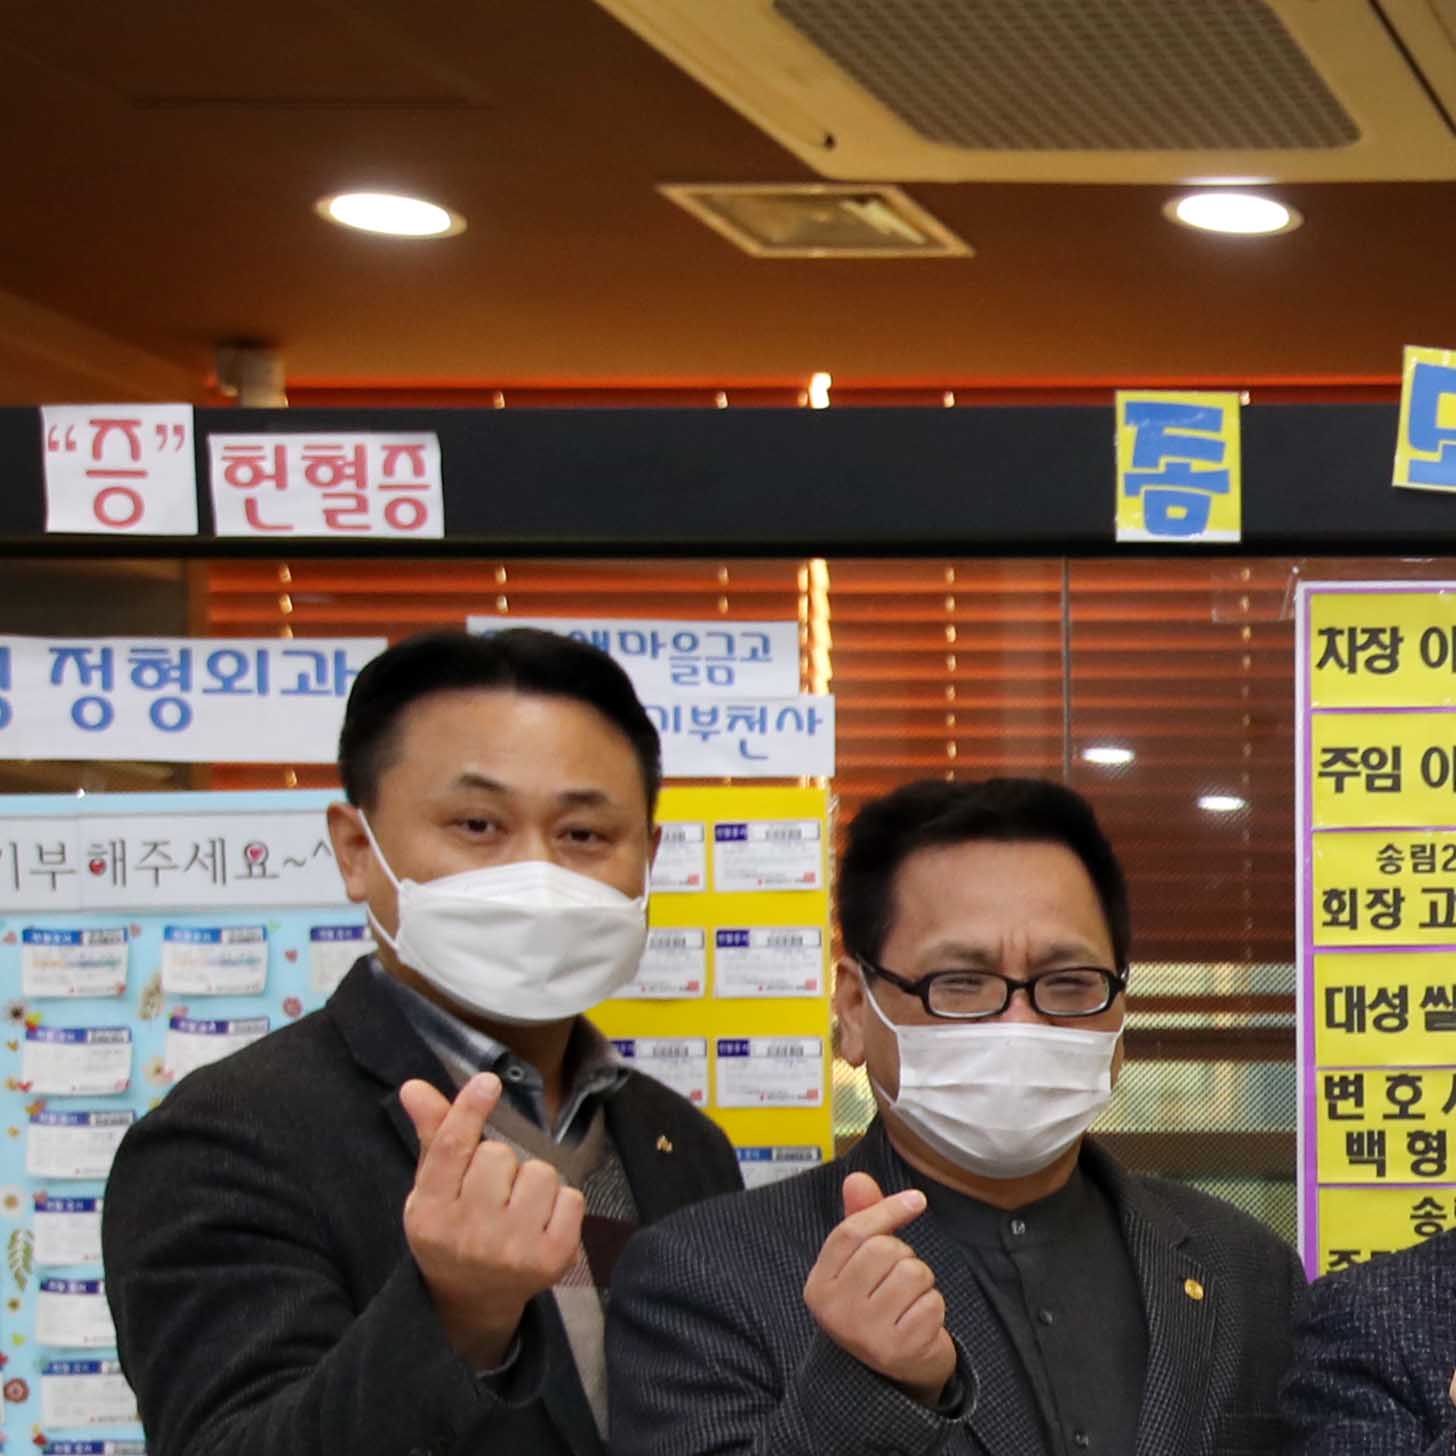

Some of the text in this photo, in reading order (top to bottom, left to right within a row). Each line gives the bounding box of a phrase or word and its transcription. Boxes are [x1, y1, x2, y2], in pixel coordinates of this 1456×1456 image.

[224, 443, 430, 532] 헌혈증
[1317, 627, 1403, 674] 차장
[51, 647, 352, 733] 정형외과
[1319, 747, 1400, 792] 주임
[1323, 888, 1404, 930] 회장
[1325, 986, 1408, 1033] 대성
